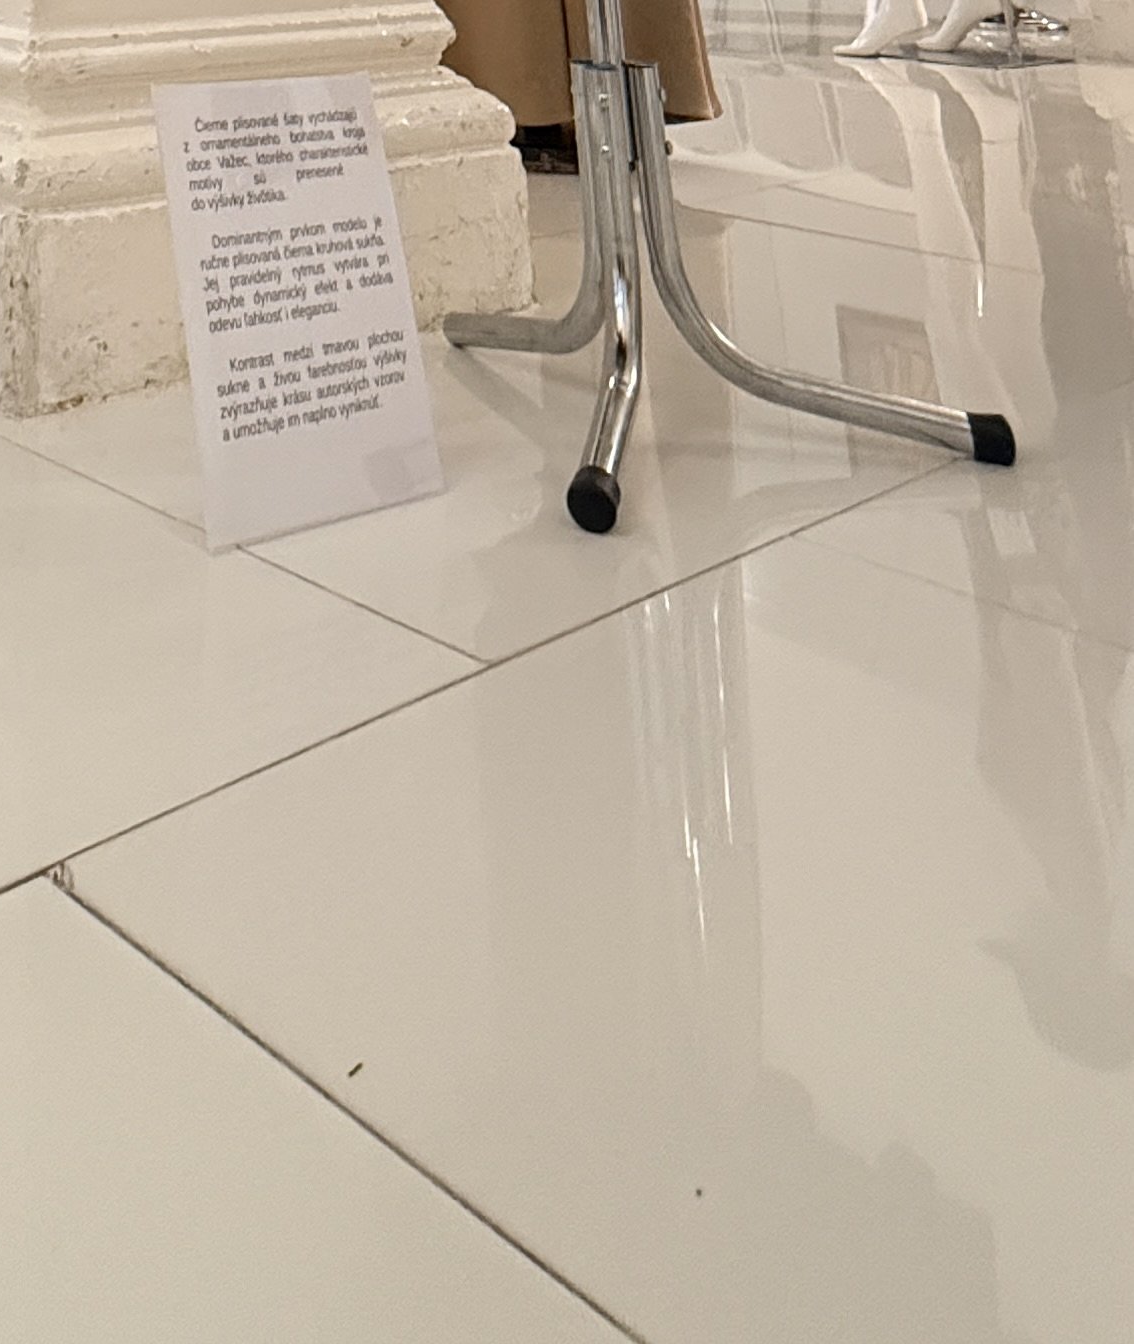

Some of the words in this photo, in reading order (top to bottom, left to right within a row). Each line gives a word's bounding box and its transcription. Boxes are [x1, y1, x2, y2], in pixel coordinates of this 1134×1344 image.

[233, 113, 278, 130] plisované
[200, 133, 280, 151] ornamentálneho
[187, 158, 211, 171] obce
[256, 150, 293, 165] ktorého
[208, 193, 245, 212] výšivky
[212, 227, 282, 249] Dominantným
[290, 222, 325, 240] prvkom
[333, 217, 366, 232] modelu
[201, 257, 229, 271] ručne
[232, 249, 280, 268] plisovaná
[283, 244, 313, 260] čierna
[316, 240, 353, 256] kruhová
[204, 278, 219, 293] Jej
[230, 268, 282, 290] pravidelný
[292, 263, 325, 280] rytmus
[206, 295, 244, 314] pohybe
[254, 285, 306, 307] dynamický
[209, 317, 242, 333] odevu
[244, 310, 282, 328] ľahkosť
[230, 353, 274, 373] Kontrast
[284, 345, 314, 362] medzi
[323, 339, 359, 355] tmavou
[368, 329, 403, 349] plochou
[217, 380, 250, 397] sukne
[274, 371, 301, 386] živou
[373, 349, 407, 369] výšivky
[221, 395, 277, 420] zvýrazňuje
[283, 389, 311, 406] krásu
[317, 377, 369, 400] autorských
[375, 371, 405, 388] vzorov
[233, 416, 285, 439] umožňuje
[303, 406, 336, 425] naplno
